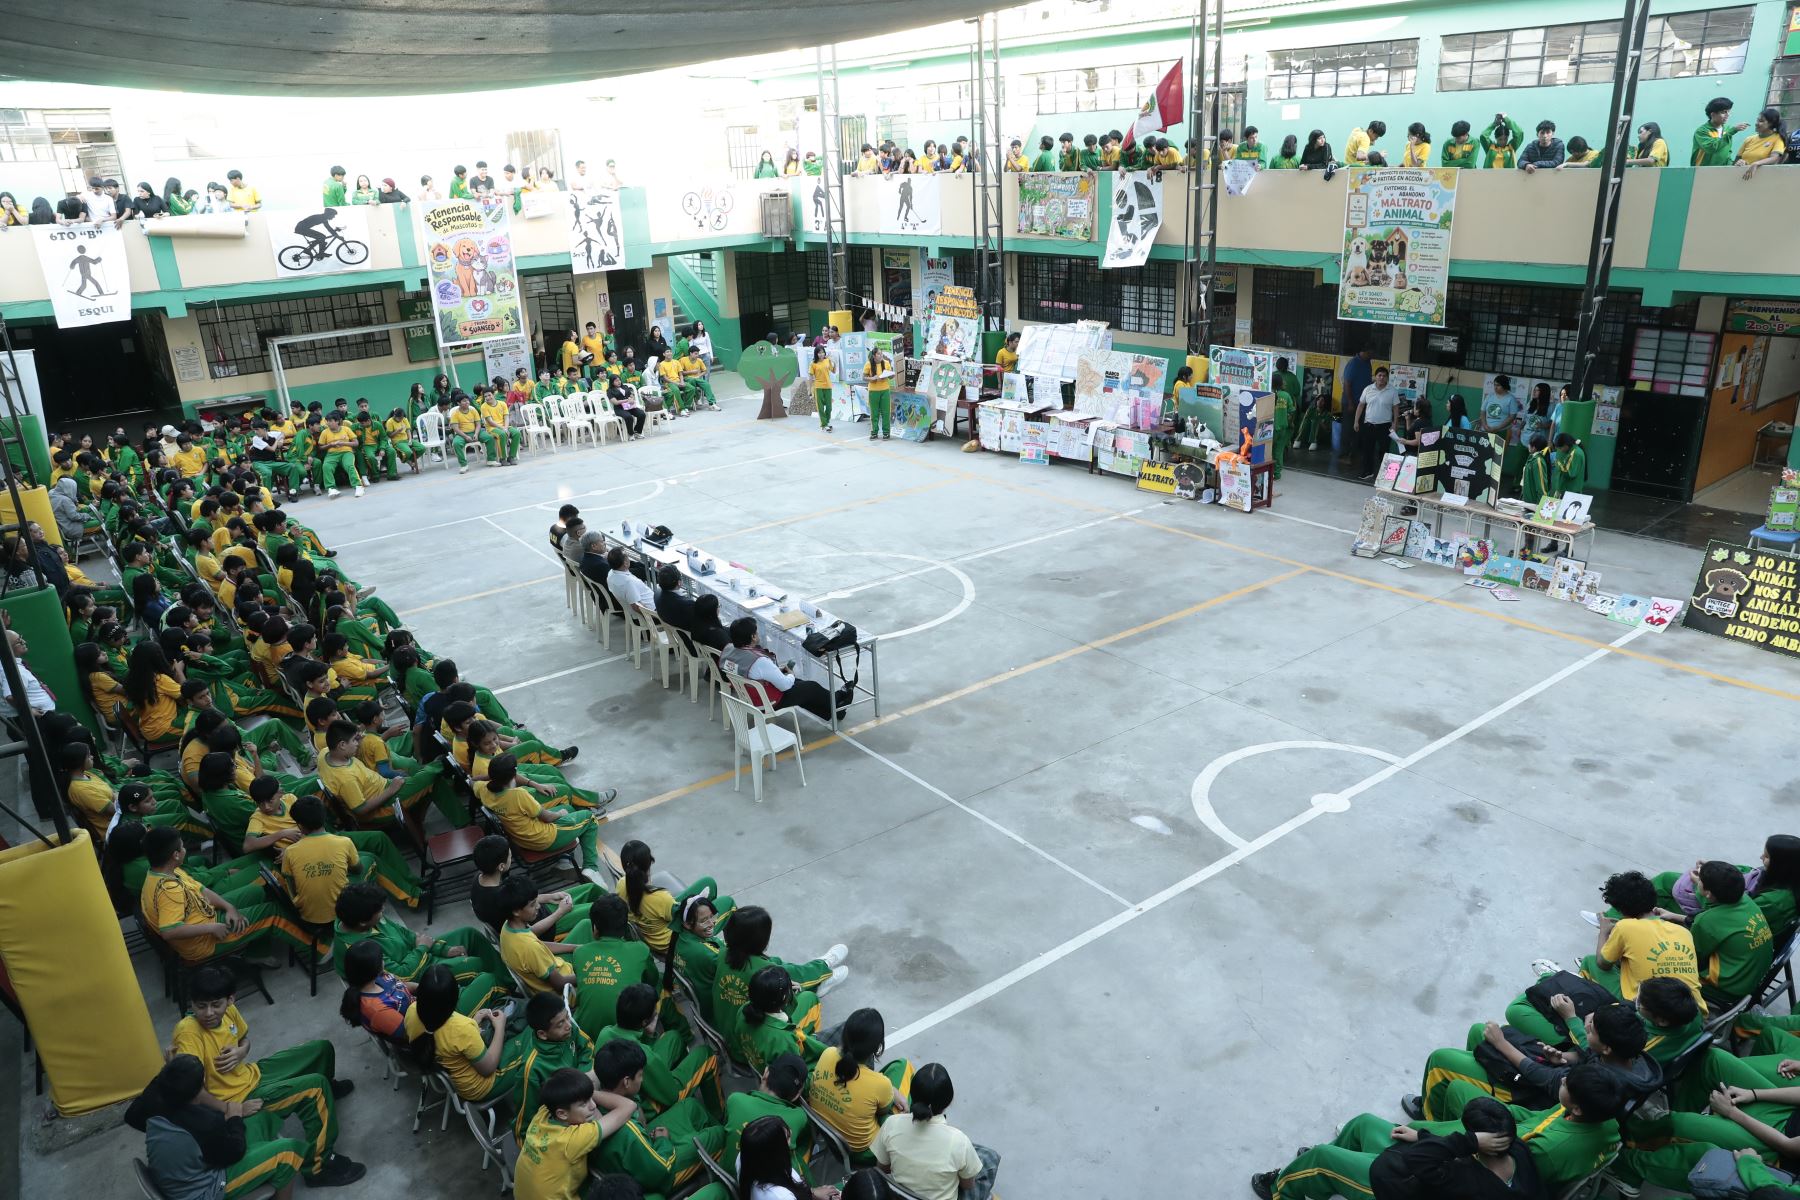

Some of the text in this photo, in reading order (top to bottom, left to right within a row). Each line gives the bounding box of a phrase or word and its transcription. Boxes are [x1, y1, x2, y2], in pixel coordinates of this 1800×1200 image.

[1381, 198, 1433, 210] MALTRATO
[430, 203, 470, 220] Tenencia
[1383, 208, 1424, 220] ANIMAL
[430, 211, 482, 231] Responsable
[450, 222, 478, 231] Mascotas
[49, 231, 77, 241] 6TO
[78, 306, 114, 316] ESQUI
[409, 325, 431, 338] DEL
[468, 324, 496, 335] SUANSED
[1221, 365, 1252, 376] PATITAS
[1146, 460, 1156, 468] NO
[1138, 471, 1175, 486] MALTRATO
[1755, 555, 1797, 574] NO AL
[1748, 569, 1797, 589] ANIMAL
[1739, 610, 1800, 633] CUIDEMO
[1725, 624, 1768, 643] MEDIO
[820, 1097, 845, 1114] PINOS
